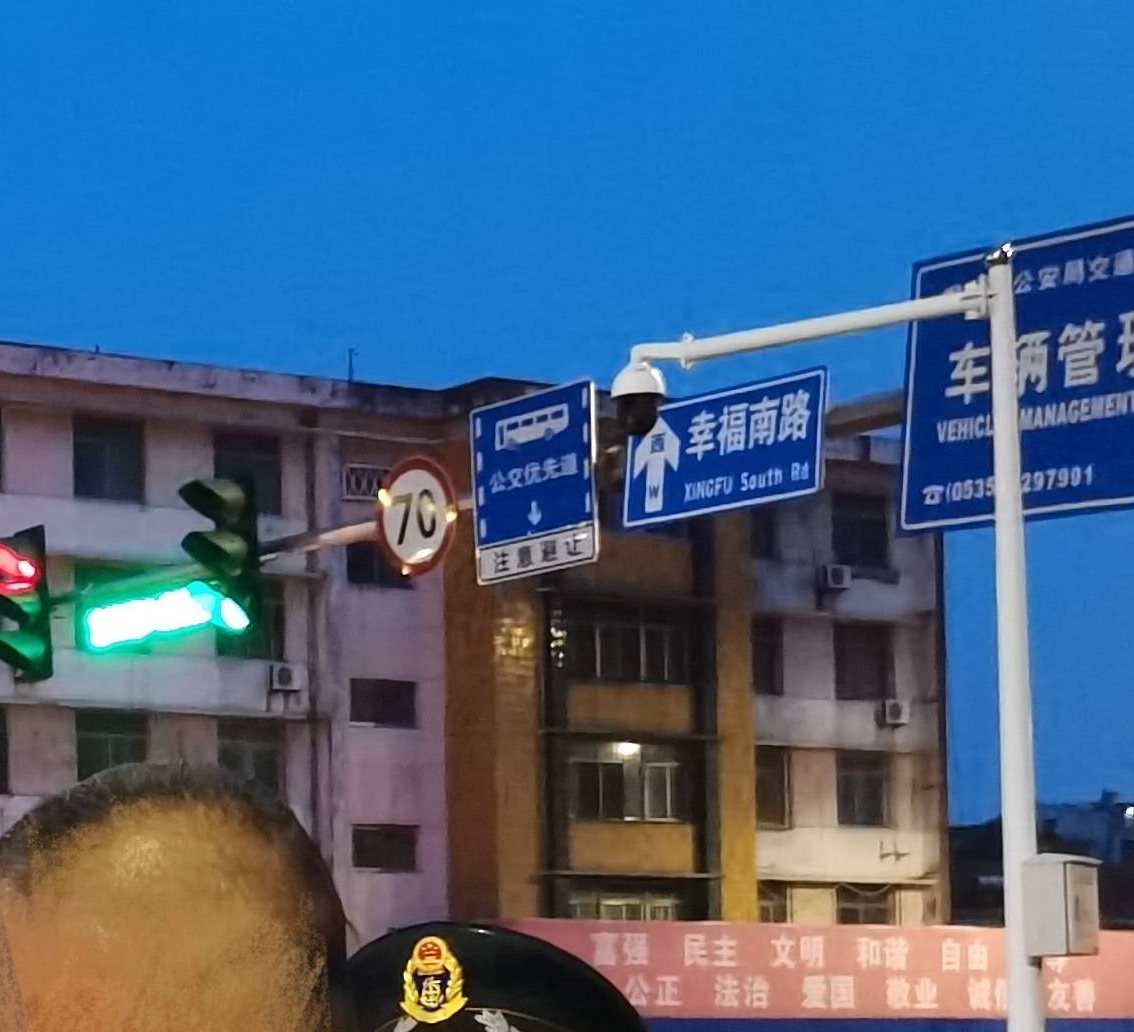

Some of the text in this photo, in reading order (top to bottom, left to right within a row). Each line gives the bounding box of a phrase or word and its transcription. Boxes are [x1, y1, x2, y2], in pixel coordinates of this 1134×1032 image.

[685, 388, 812, 462] 幸福南路
[937, 414, 995, 444] VEHICL
[683, 460, 810, 503] XINGFU South Rd
[391, 489, 437, 546] 70
[591, 932, 989, 972] 富强 民主 文明 和谐 自由
[625, 974, 681, 1007] 公正
[714, 975, 770, 1009] 法治
[801, 975, 856, 1010] 爱国
[885, 976, 939, 1010] 敬业
[1046, 978, 1096, 1013] 友善
